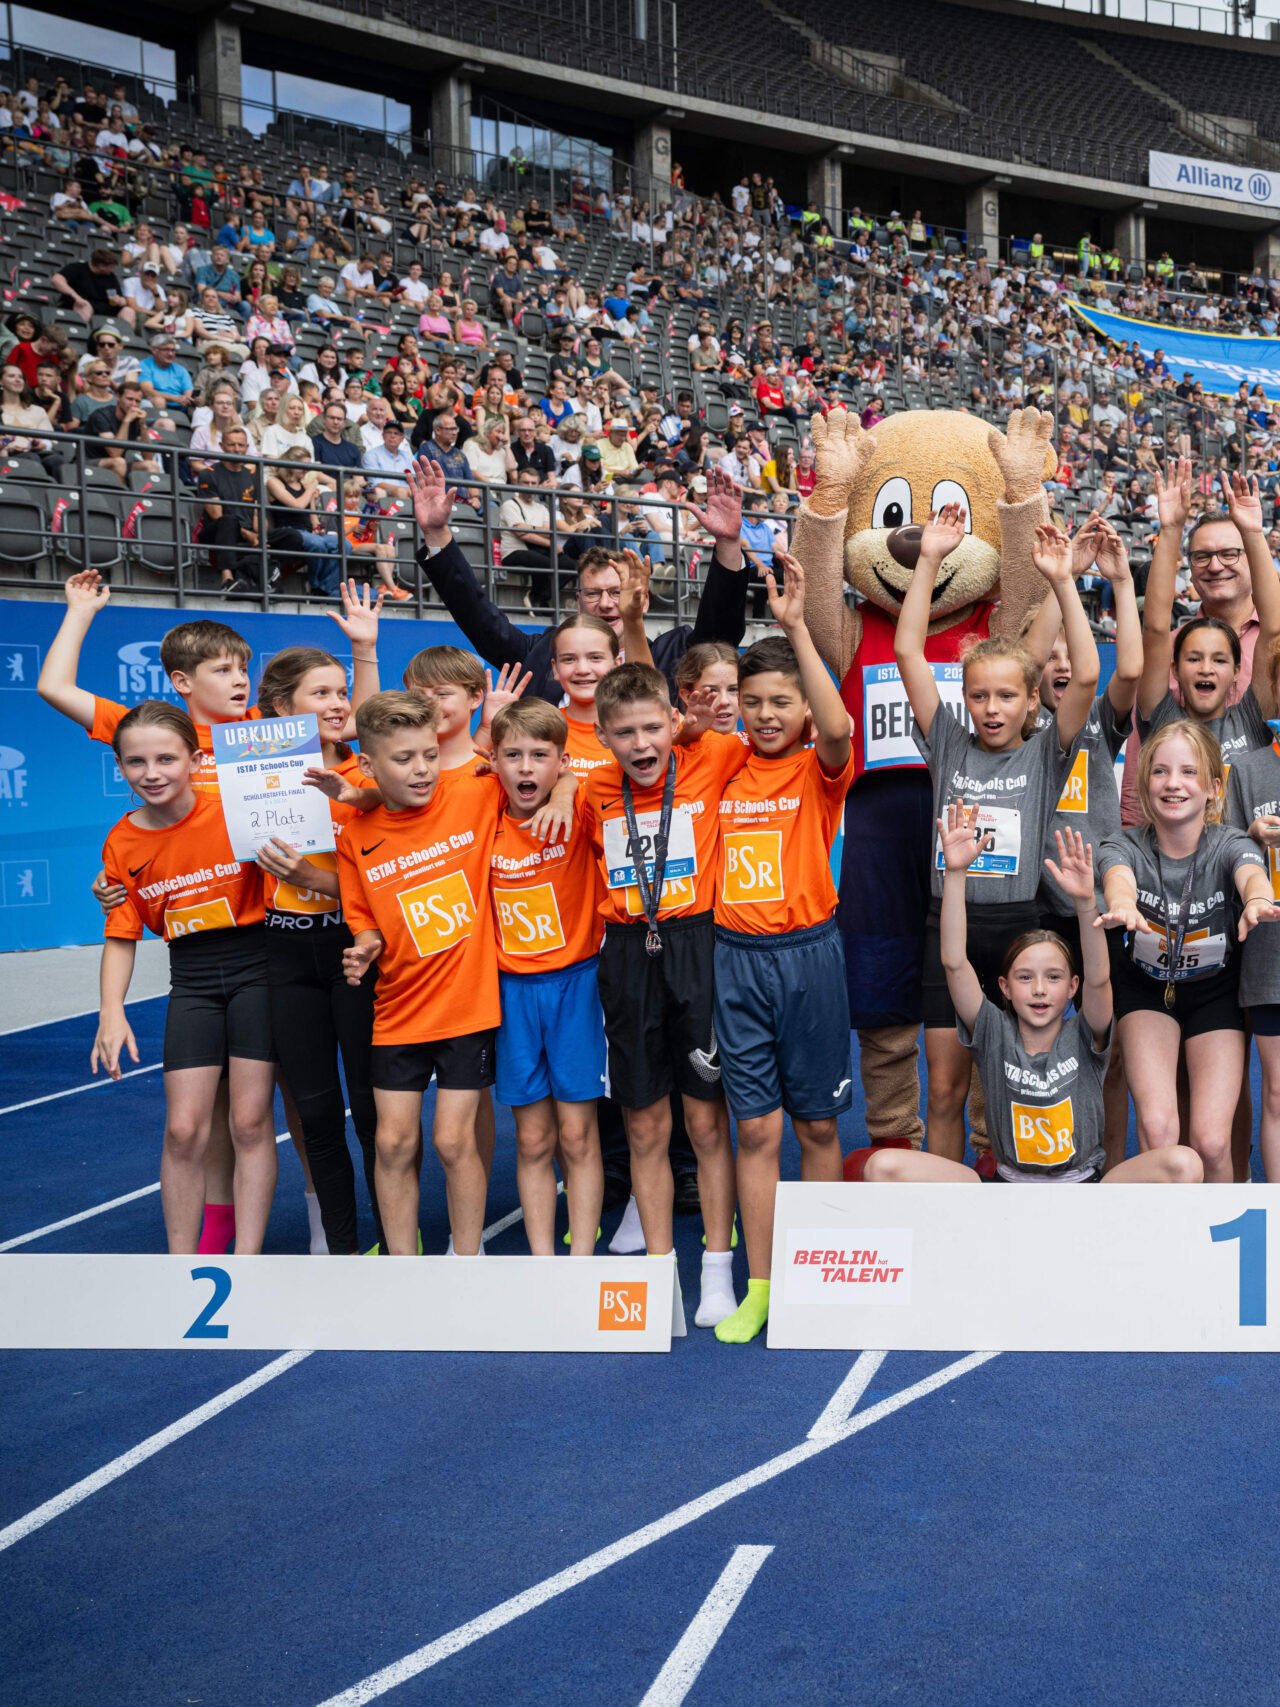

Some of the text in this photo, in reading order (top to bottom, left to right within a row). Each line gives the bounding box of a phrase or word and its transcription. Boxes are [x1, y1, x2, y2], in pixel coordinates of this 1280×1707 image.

[656, 136, 669, 156] G
[1176, 163, 1244, 193] Allianz
[985, 200, 997, 217] G
[119, 664, 178, 693] ISTA
[877, 667, 963, 680] ISTA 202
[225, 720, 307, 746] URKUNDE
[237, 759, 305, 774] ISTAF Schools Cup
[734, 799, 777, 814] Schools
[1253, 801, 1279, 819] TAF
[266, 808, 307, 827] Platz
[365, 830, 475, 883] ISTAF Schools Cup
[542, 843, 566, 861] Cup
[213, 862, 242, 878] Cup
[435, 859, 446, 869] von
[728, 845, 776, 890] BSR
[270, 915, 314, 930] PRO
[408, 894, 473, 937] BSR
[499, 902, 557, 942] BSR
[1057, 1056, 1079, 1076] Cup
[1019, 1114, 1071, 1156] BSR
[793, 1249, 878, 1265] BERLIN
[1208, 1207, 1267, 1326] 1
[820, 1267, 904, 1283] TALENT
[182, 1266, 232, 1339] 2
[603, 1289, 643, 1323] BSR
